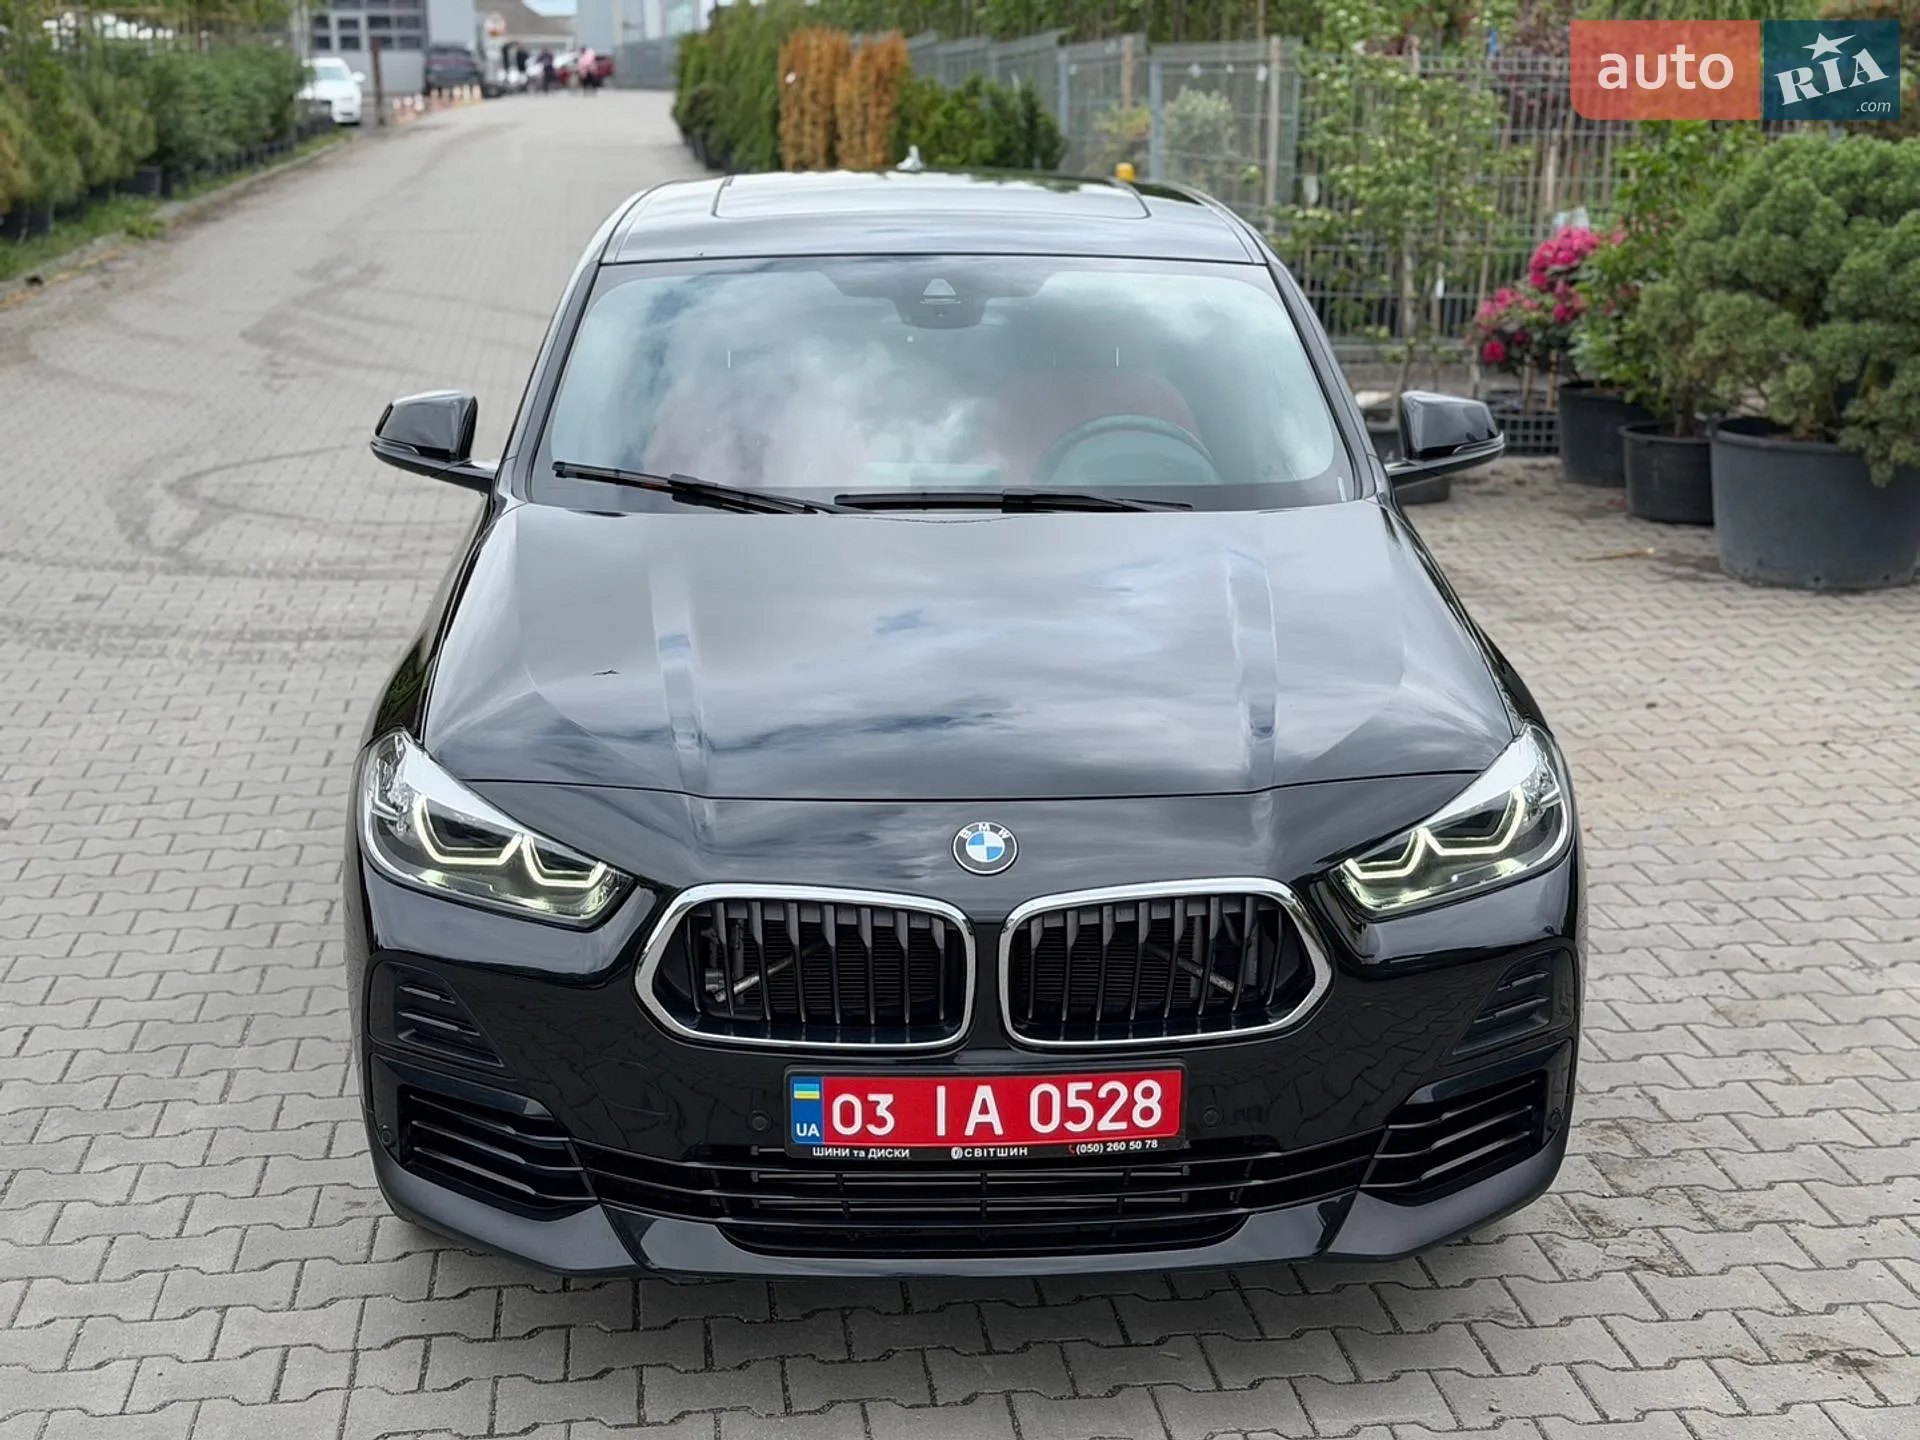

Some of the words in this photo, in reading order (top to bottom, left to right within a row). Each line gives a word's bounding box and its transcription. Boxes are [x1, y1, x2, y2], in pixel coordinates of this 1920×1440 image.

[832, 1093, 895, 1136] 03
[1029, 1079, 1162, 1134] 0528
[796, 1122, 820, 1138] UA
[812, 1146, 850, 1157] ШИНИ
[853, 1149, 866, 1158] та
[867, 1148, 910, 1159] ДИСКИ
[1075, 1143, 1104, 1155] (050)
[1106, 1141, 1126, 1152] 260
[1129, 1140, 1143, 1150] 50
[1145, 1139, 1159, 1149] 78
